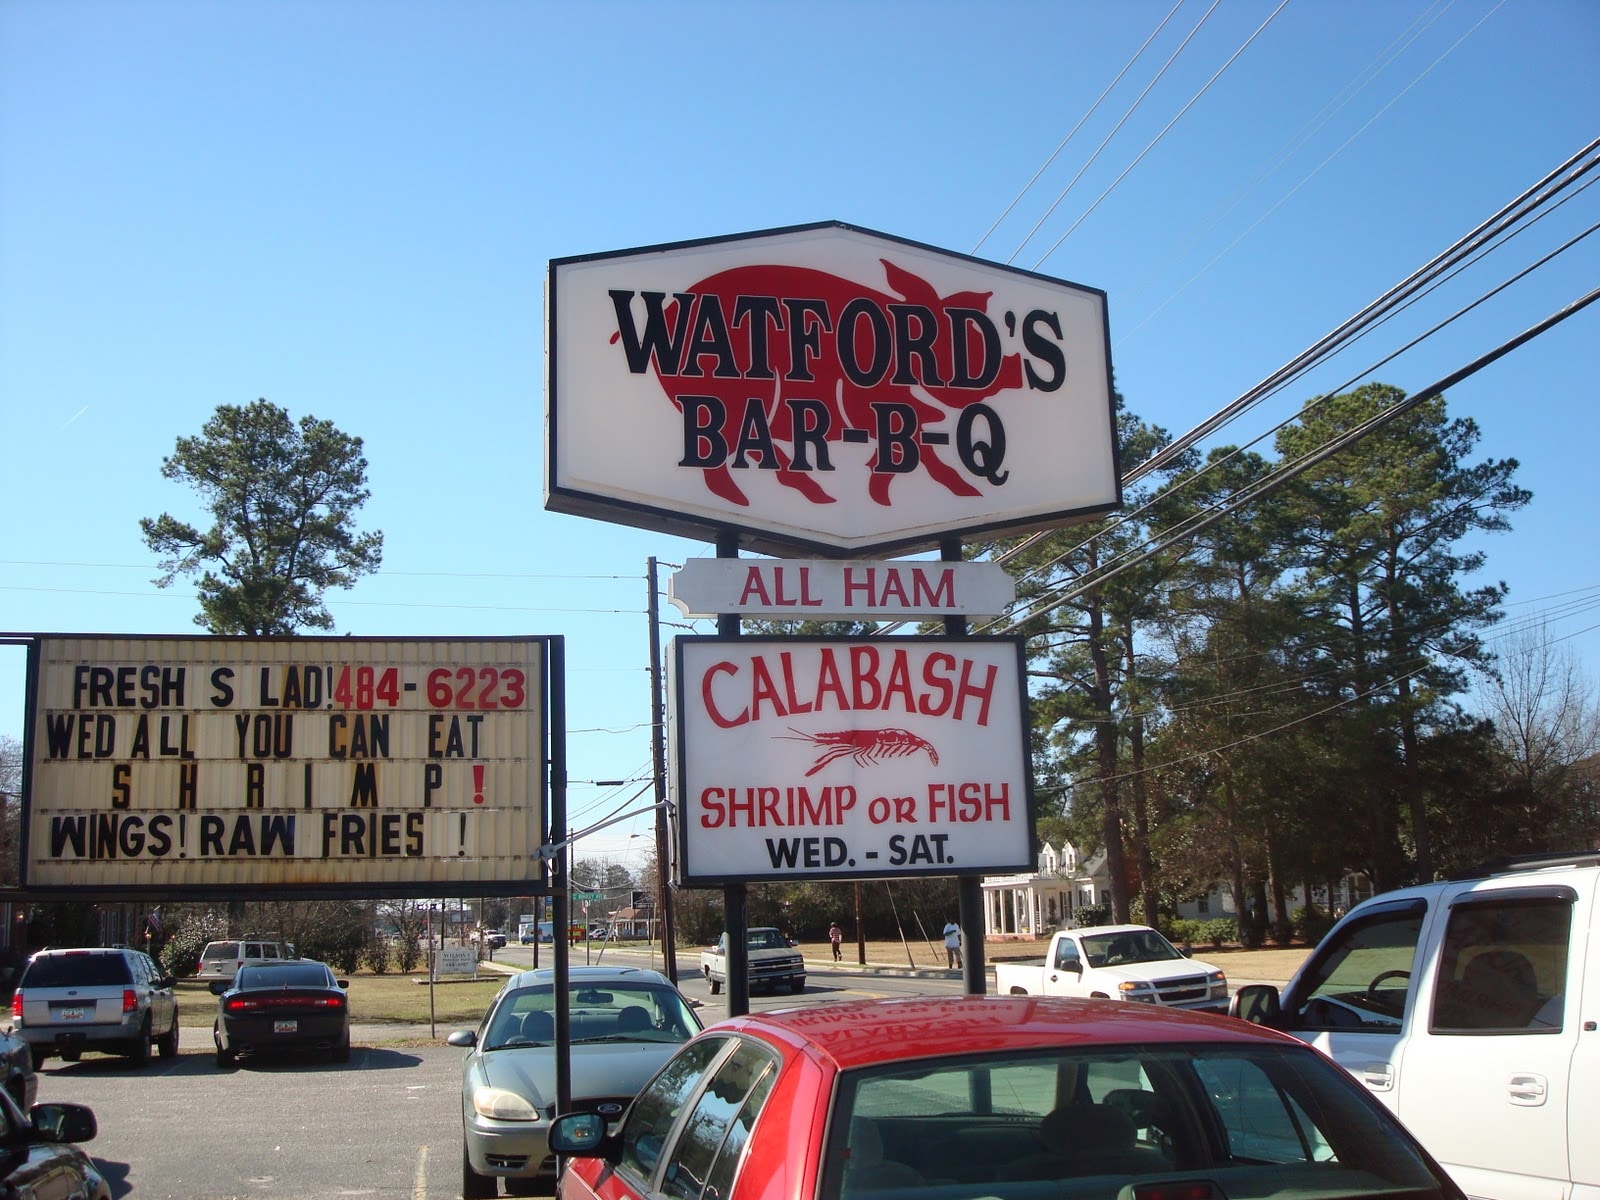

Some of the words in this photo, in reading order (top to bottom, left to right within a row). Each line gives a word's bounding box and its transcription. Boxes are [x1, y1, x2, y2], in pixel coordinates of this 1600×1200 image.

[608, 289, 1066, 393] WATFORD'S
[677, 395, 1010, 486] BAR-B-Q
[739, 566, 823, 606] ALL
[843, 567, 956, 608] HAM
[73, 665, 186, 709] FRESH
[210, 667, 235, 708] S
[702, 645, 999, 729] CALABASH
[46, 714, 115, 759] WED
[131, 715, 195, 759] ALL
[235, 714, 294, 759] YOU
[329, 714, 390, 759] CAN
[428, 714, 484, 758] EAT
[701, 785, 857, 829] SHRIMP
[928, 782, 1011, 823] FISH
[50, 814, 187, 859] WINGS!
[200, 814, 296, 857] RAW
[322, 813, 425, 859] FRIES
[765, 837, 856, 869] WED.
[888, 834, 955, 866] SAT.
